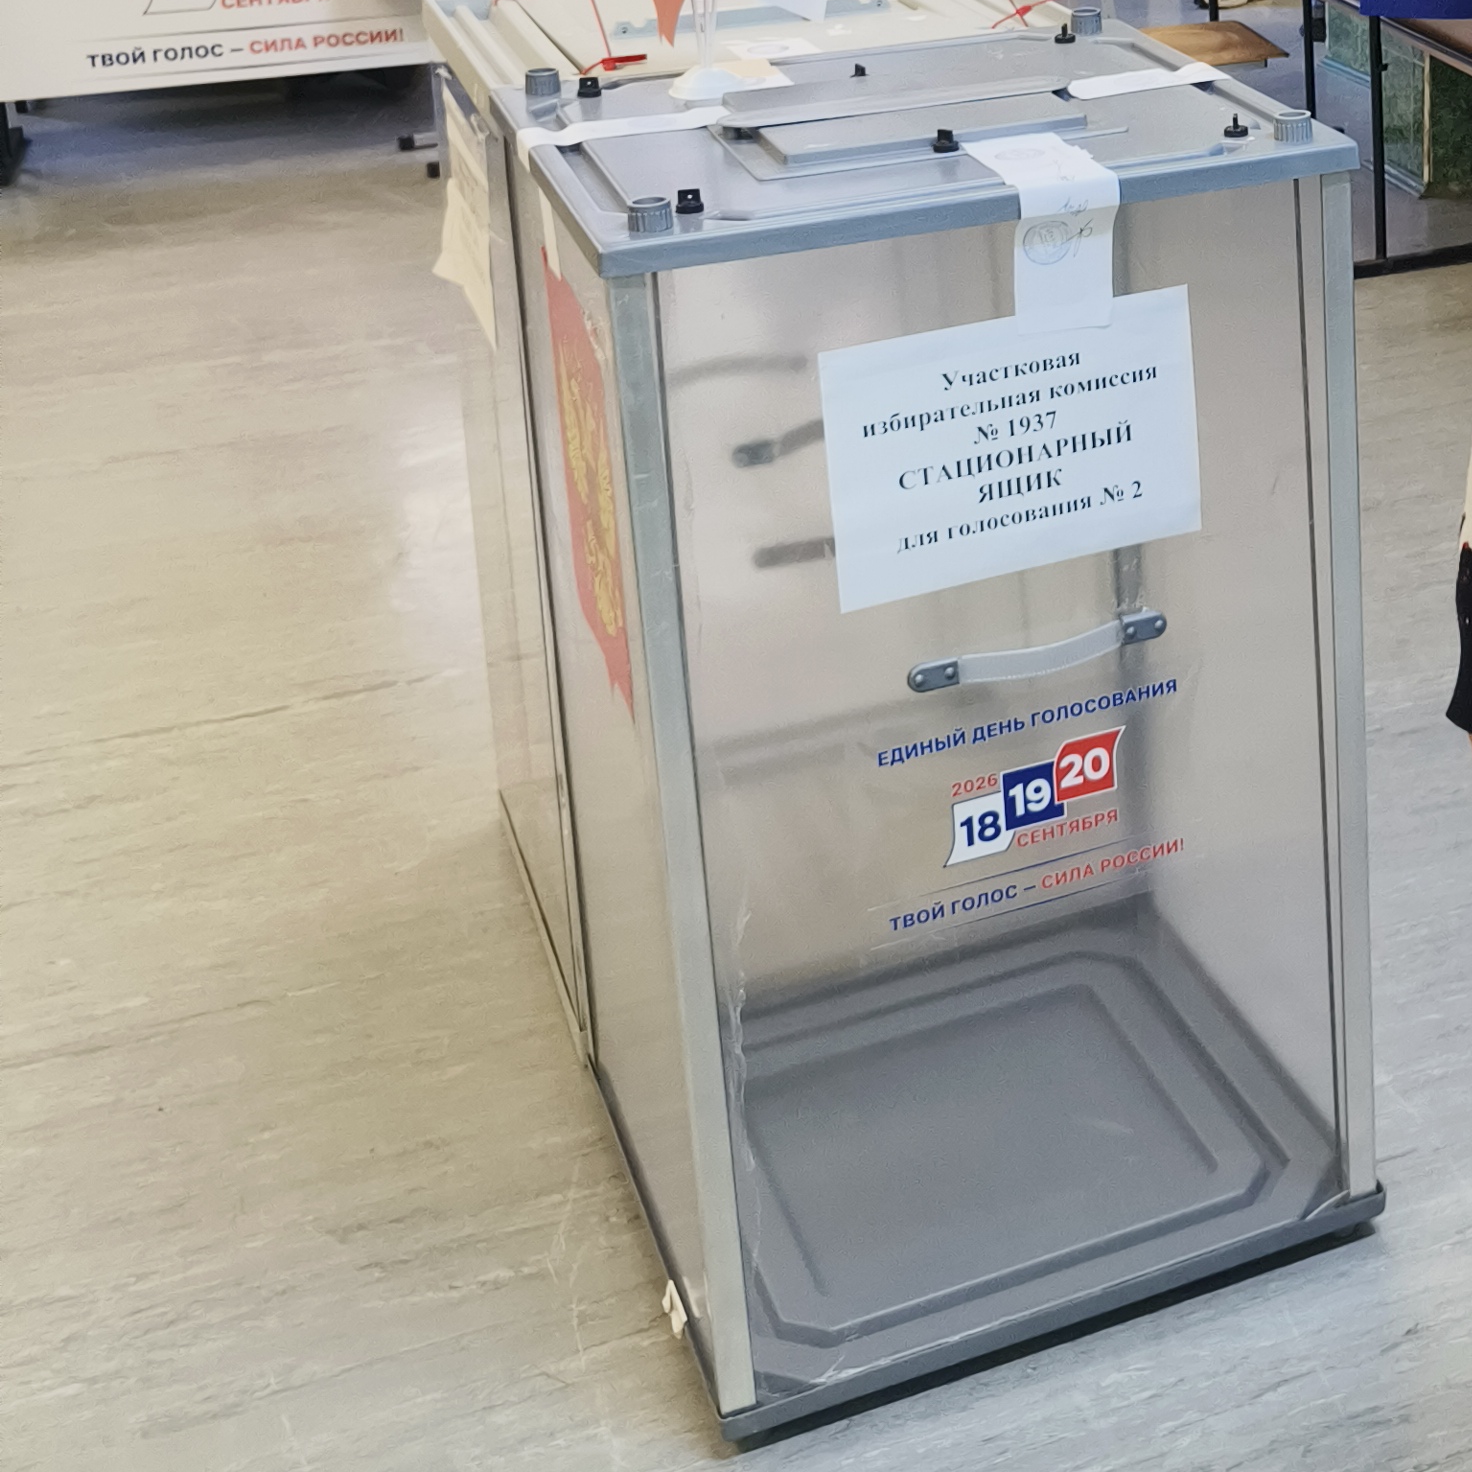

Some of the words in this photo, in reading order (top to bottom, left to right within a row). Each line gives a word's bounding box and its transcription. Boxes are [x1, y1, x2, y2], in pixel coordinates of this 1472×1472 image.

[86, 50, 146, 68] ТВОЙ
[153, 43, 225, 63] ГОЛОС
[249, 35, 307, 55] СИЛА
[313, 28, 404, 48] РОССИИ!
[940, 350, 1082, 392] Участковая
[862, 387, 1042, 439] избирательная
[1049, 365, 1158, 400] комиссия
[973, 422, 999, 445] №
[1007, 410, 1058, 438] 1937
[898, 420, 1134, 490] СТАЦИОНАРНЫЙ
[977, 468, 1063, 504] ЯЩИК
[896, 529, 940, 555] для
[947, 494, 1092, 542] голосования
[1099, 486, 1125, 507] №
[1131, 480, 1144, 498] 2
[877, 727, 967, 768] ЕДИНЫЙ
[971, 715, 1026, 745] ДЕНЬ
[1030, 678, 1178, 727] ГОЛОСОВАНИЯ
[951, 773, 998, 797] 2026
[959, 810, 1003, 848] 18
[1007, 778, 1052, 818] 19
[1058, 747, 1110, 789] 20
[1016, 808, 1119, 848] СЕНТЯБРЯ
[889, 901, 945, 932] ТВОЙ
[951, 884, 1018, 915] ГОЛОС
[1041, 863, 1096, 890] СИЛА
[1101, 837, 1185, 874] РОССИИ!
